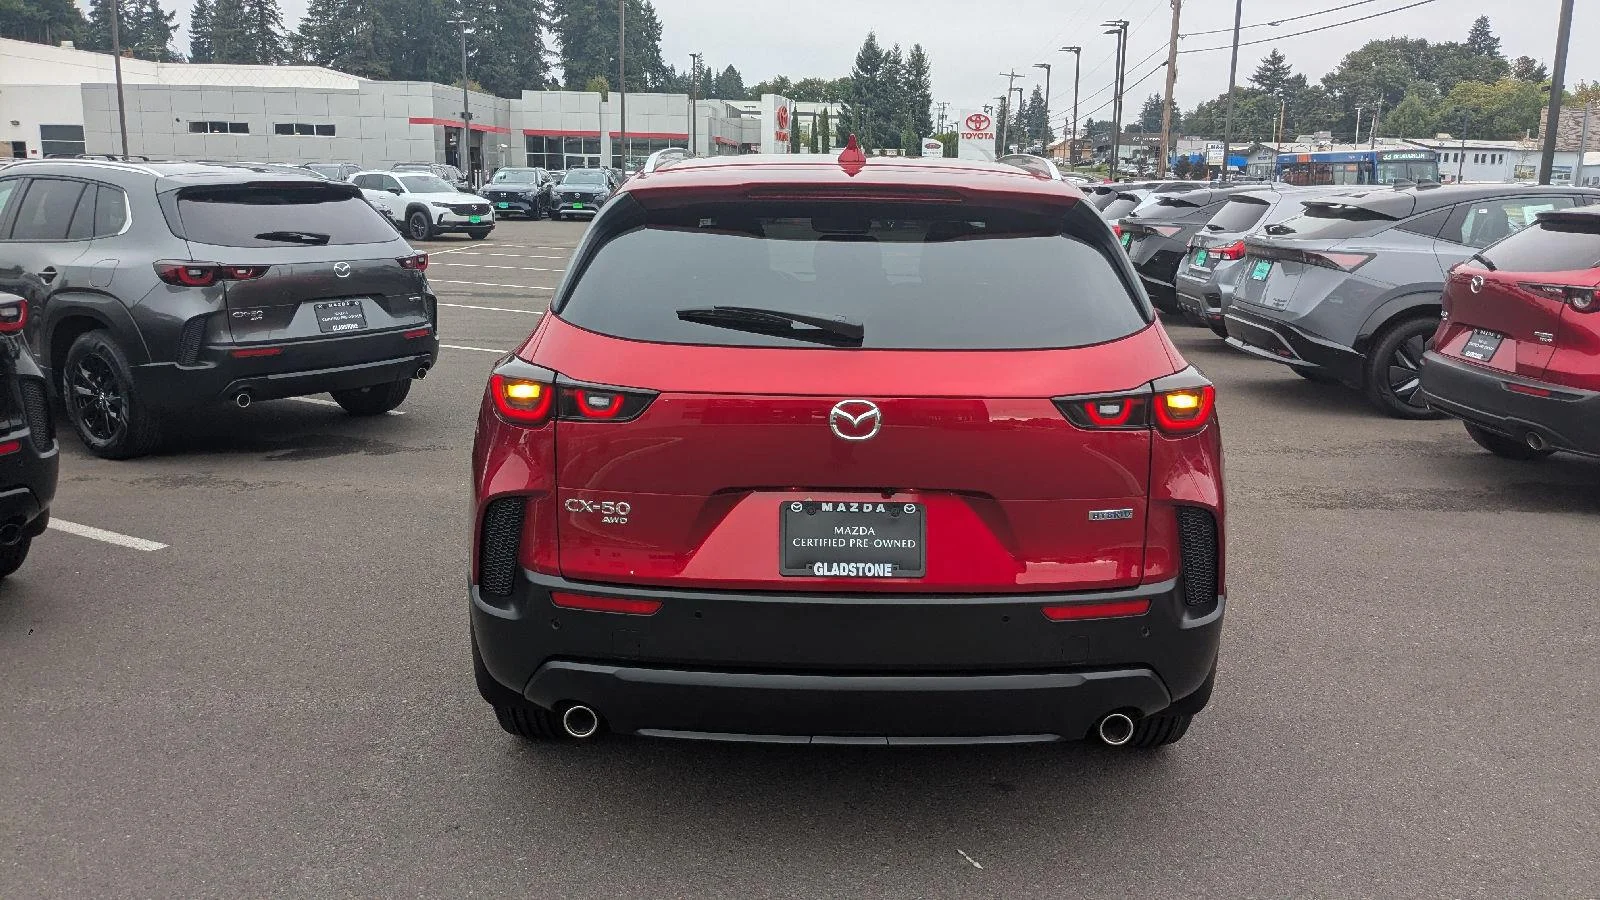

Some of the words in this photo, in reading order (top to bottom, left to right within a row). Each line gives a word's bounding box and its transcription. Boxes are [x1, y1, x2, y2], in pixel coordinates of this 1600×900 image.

[961, 132, 994, 140] TOYOTA
[564, 498, 631, 516] CX-50
[821, 502, 886, 513] MAZDA
[601, 516, 628, 524] AWD
[834, 526, 876, 536] MAZDA
[792, 538, 846, 548] CERTIFIED
[850, 538, 916, 548] PRE-OWNED
[813, 562, 893, 577] GLADSTONE
